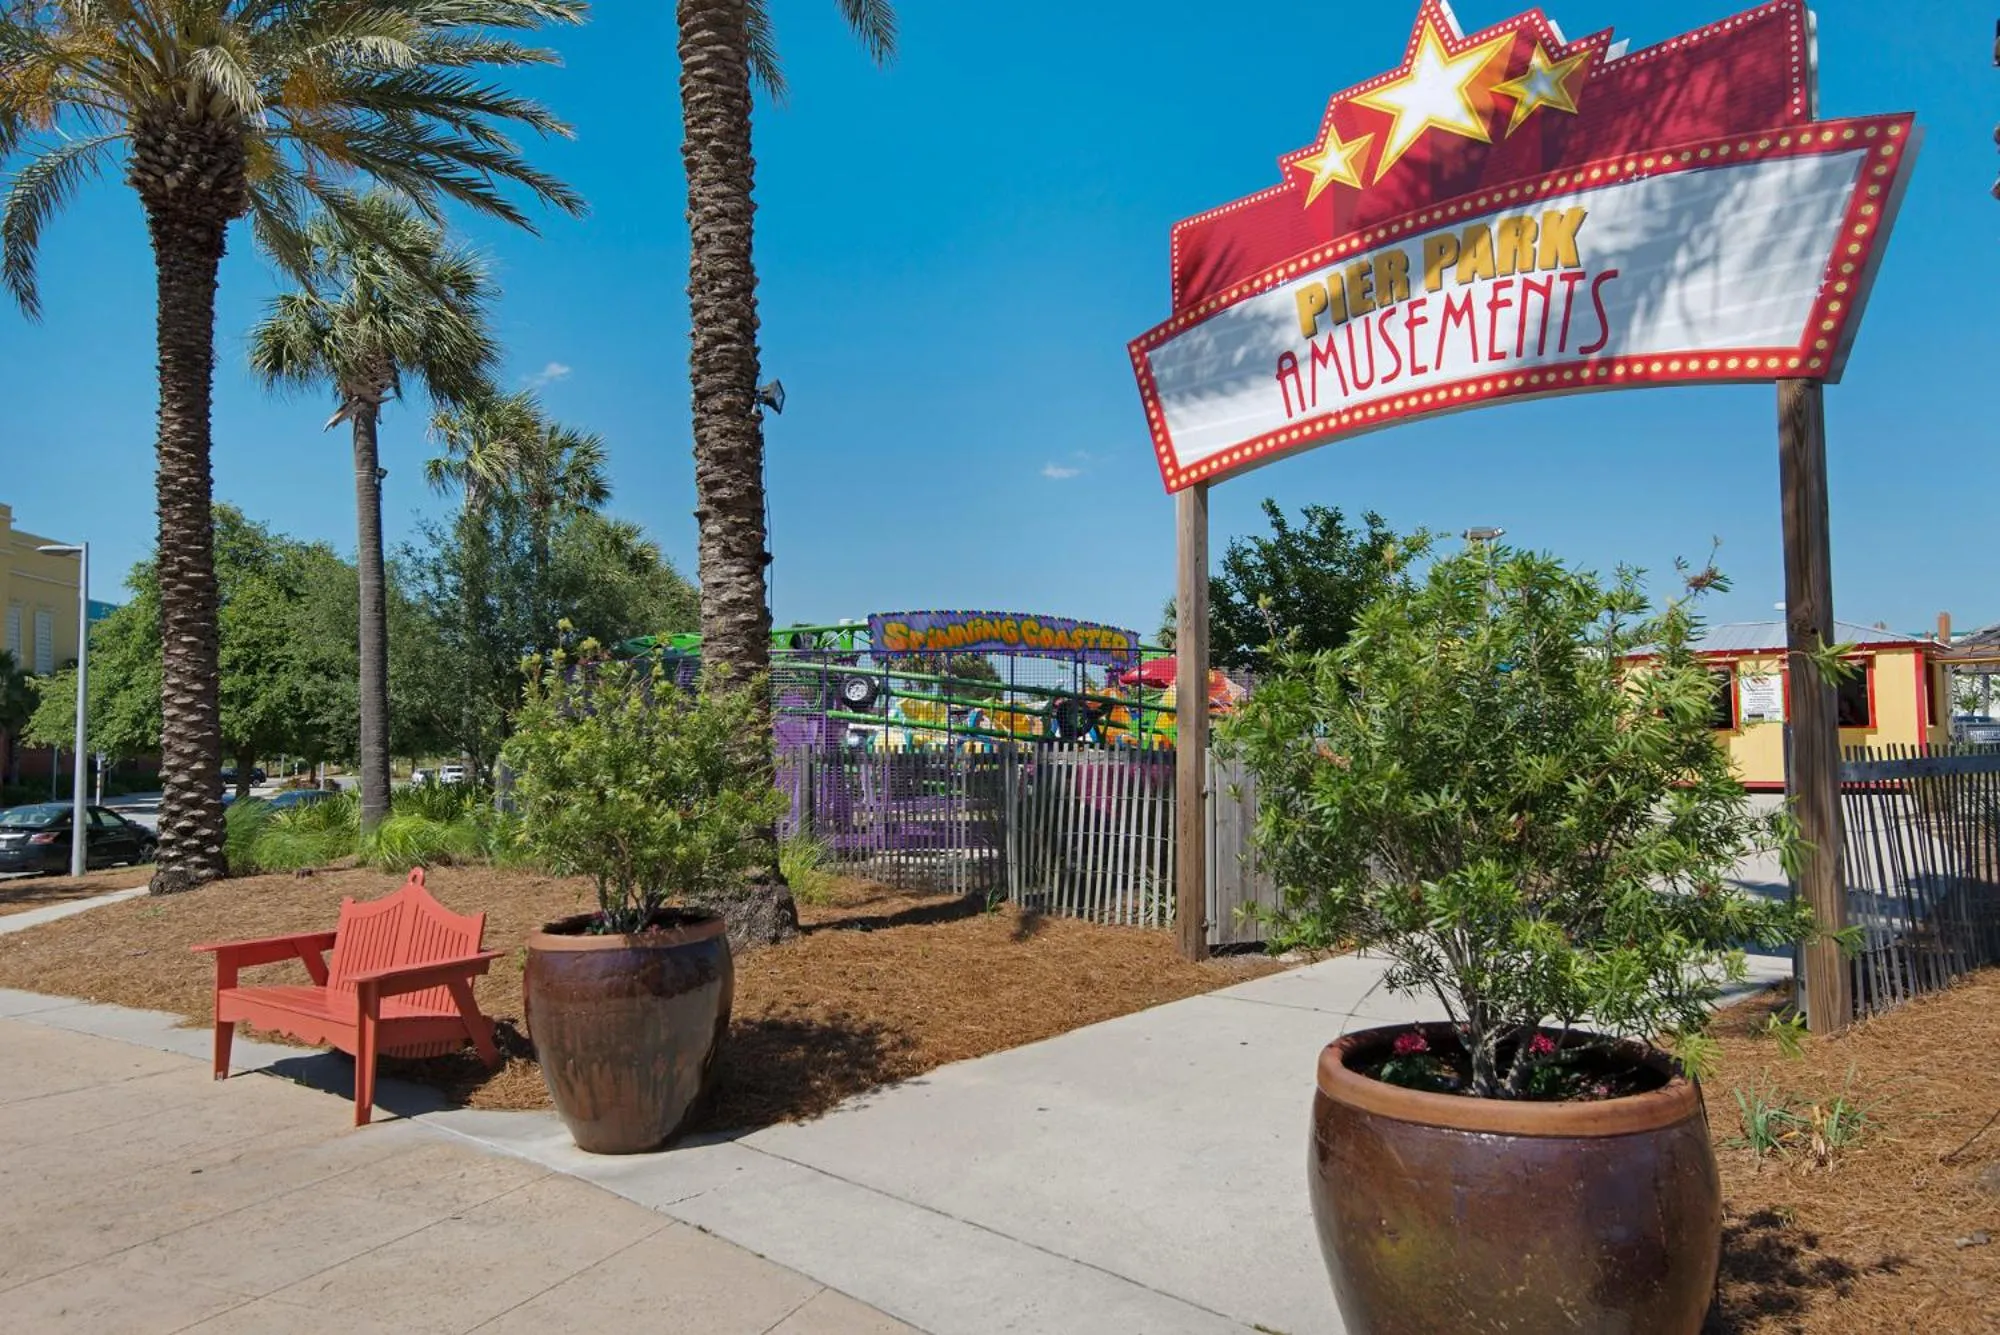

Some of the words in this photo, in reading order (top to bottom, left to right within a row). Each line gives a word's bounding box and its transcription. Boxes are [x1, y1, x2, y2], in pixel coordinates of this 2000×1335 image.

[1296, 248, 1411, 339] PIER
[1423, 207, 1588, 293] PARK
[1276, 269, 1619, 418] AMUSEMENTS
